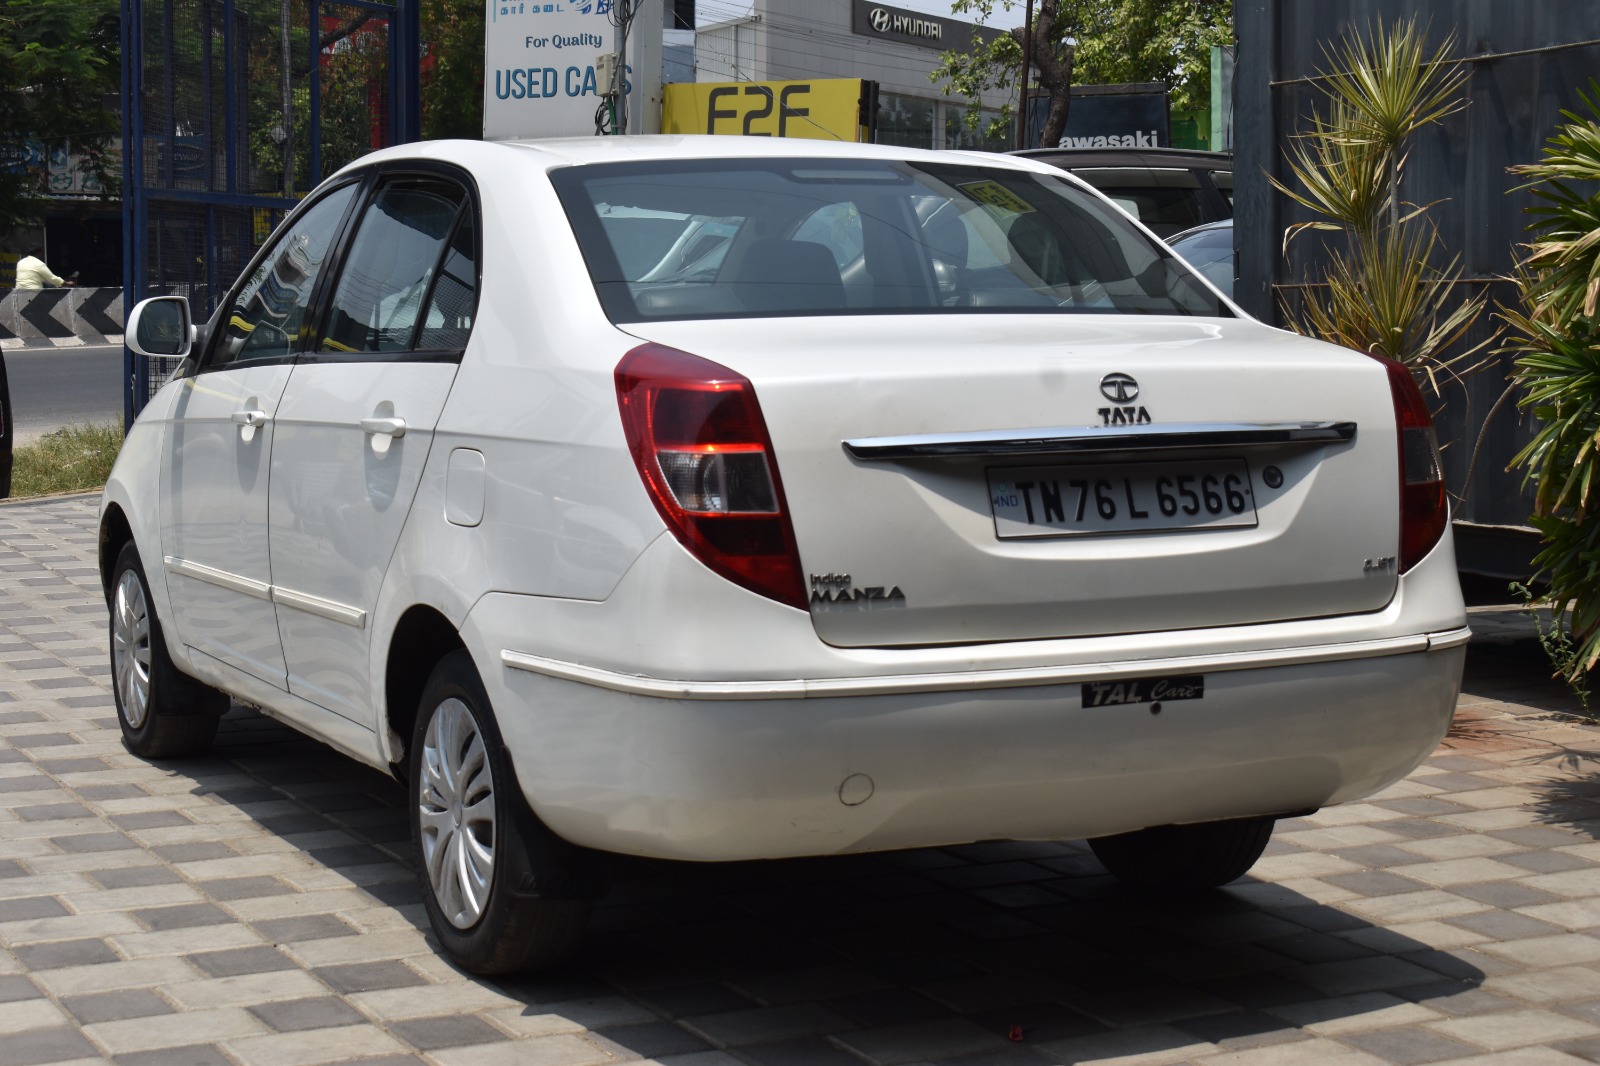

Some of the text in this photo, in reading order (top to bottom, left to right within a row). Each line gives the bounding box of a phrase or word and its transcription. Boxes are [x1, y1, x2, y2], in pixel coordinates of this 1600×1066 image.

[893, 14, 942, 39] HYUNDAI
[525, 33, 602, 48] For Quality
[496, 67, 558, 99] USED
[707, 84, 810, 137] F2F
[1059, 130, 1158, 148] awasaki
[1098, 406, 1151, 425] TATA
[1124, 477, 1149, 518] L
[1156, 474, 1245, 517] 6566
[810, 586, 906, 606] MANZA
[1091, 683, 1142, 706] TAL
